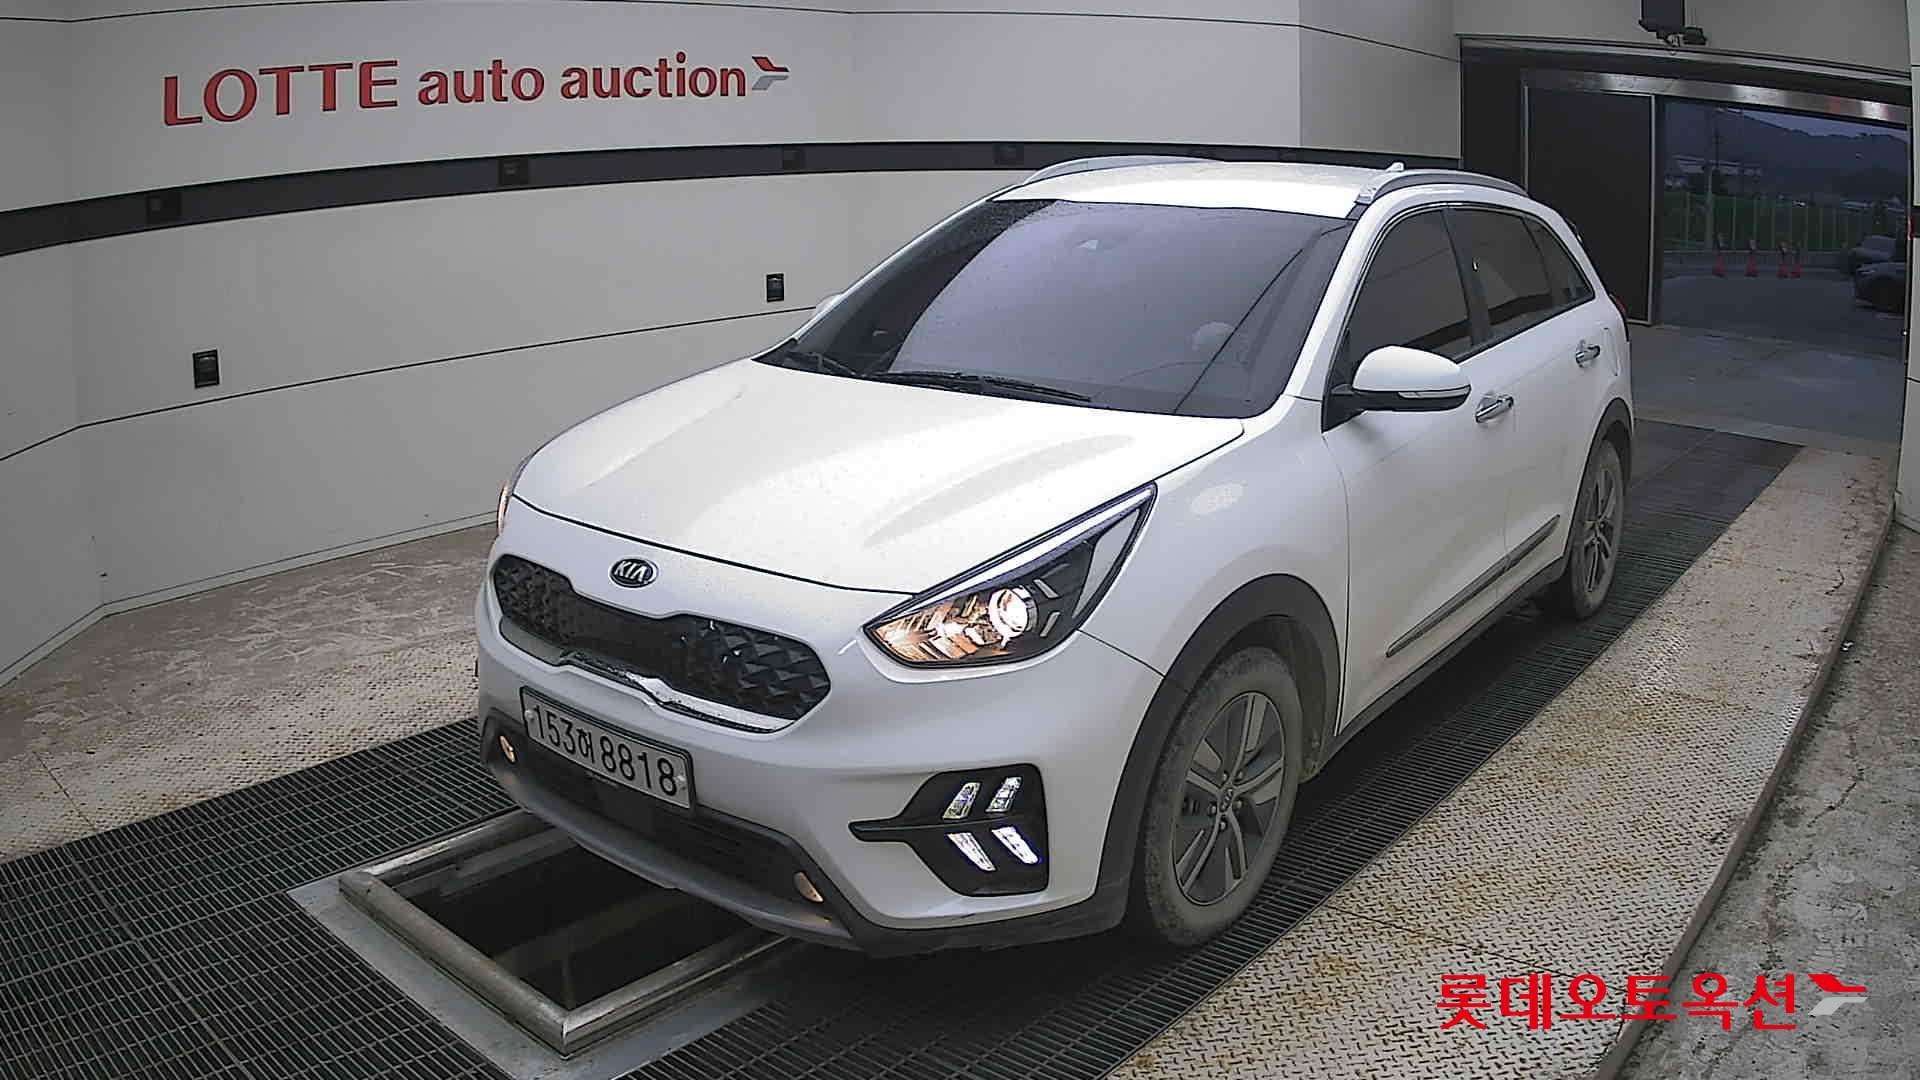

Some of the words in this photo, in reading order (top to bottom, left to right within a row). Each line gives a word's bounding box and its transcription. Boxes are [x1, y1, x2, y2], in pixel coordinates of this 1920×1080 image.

[163, 59, 398, 126] LOTTE
[417, 58, 545, 105] auto
[560, 51, 747, 99] auction
[614, 560, 648, 582] KIA
